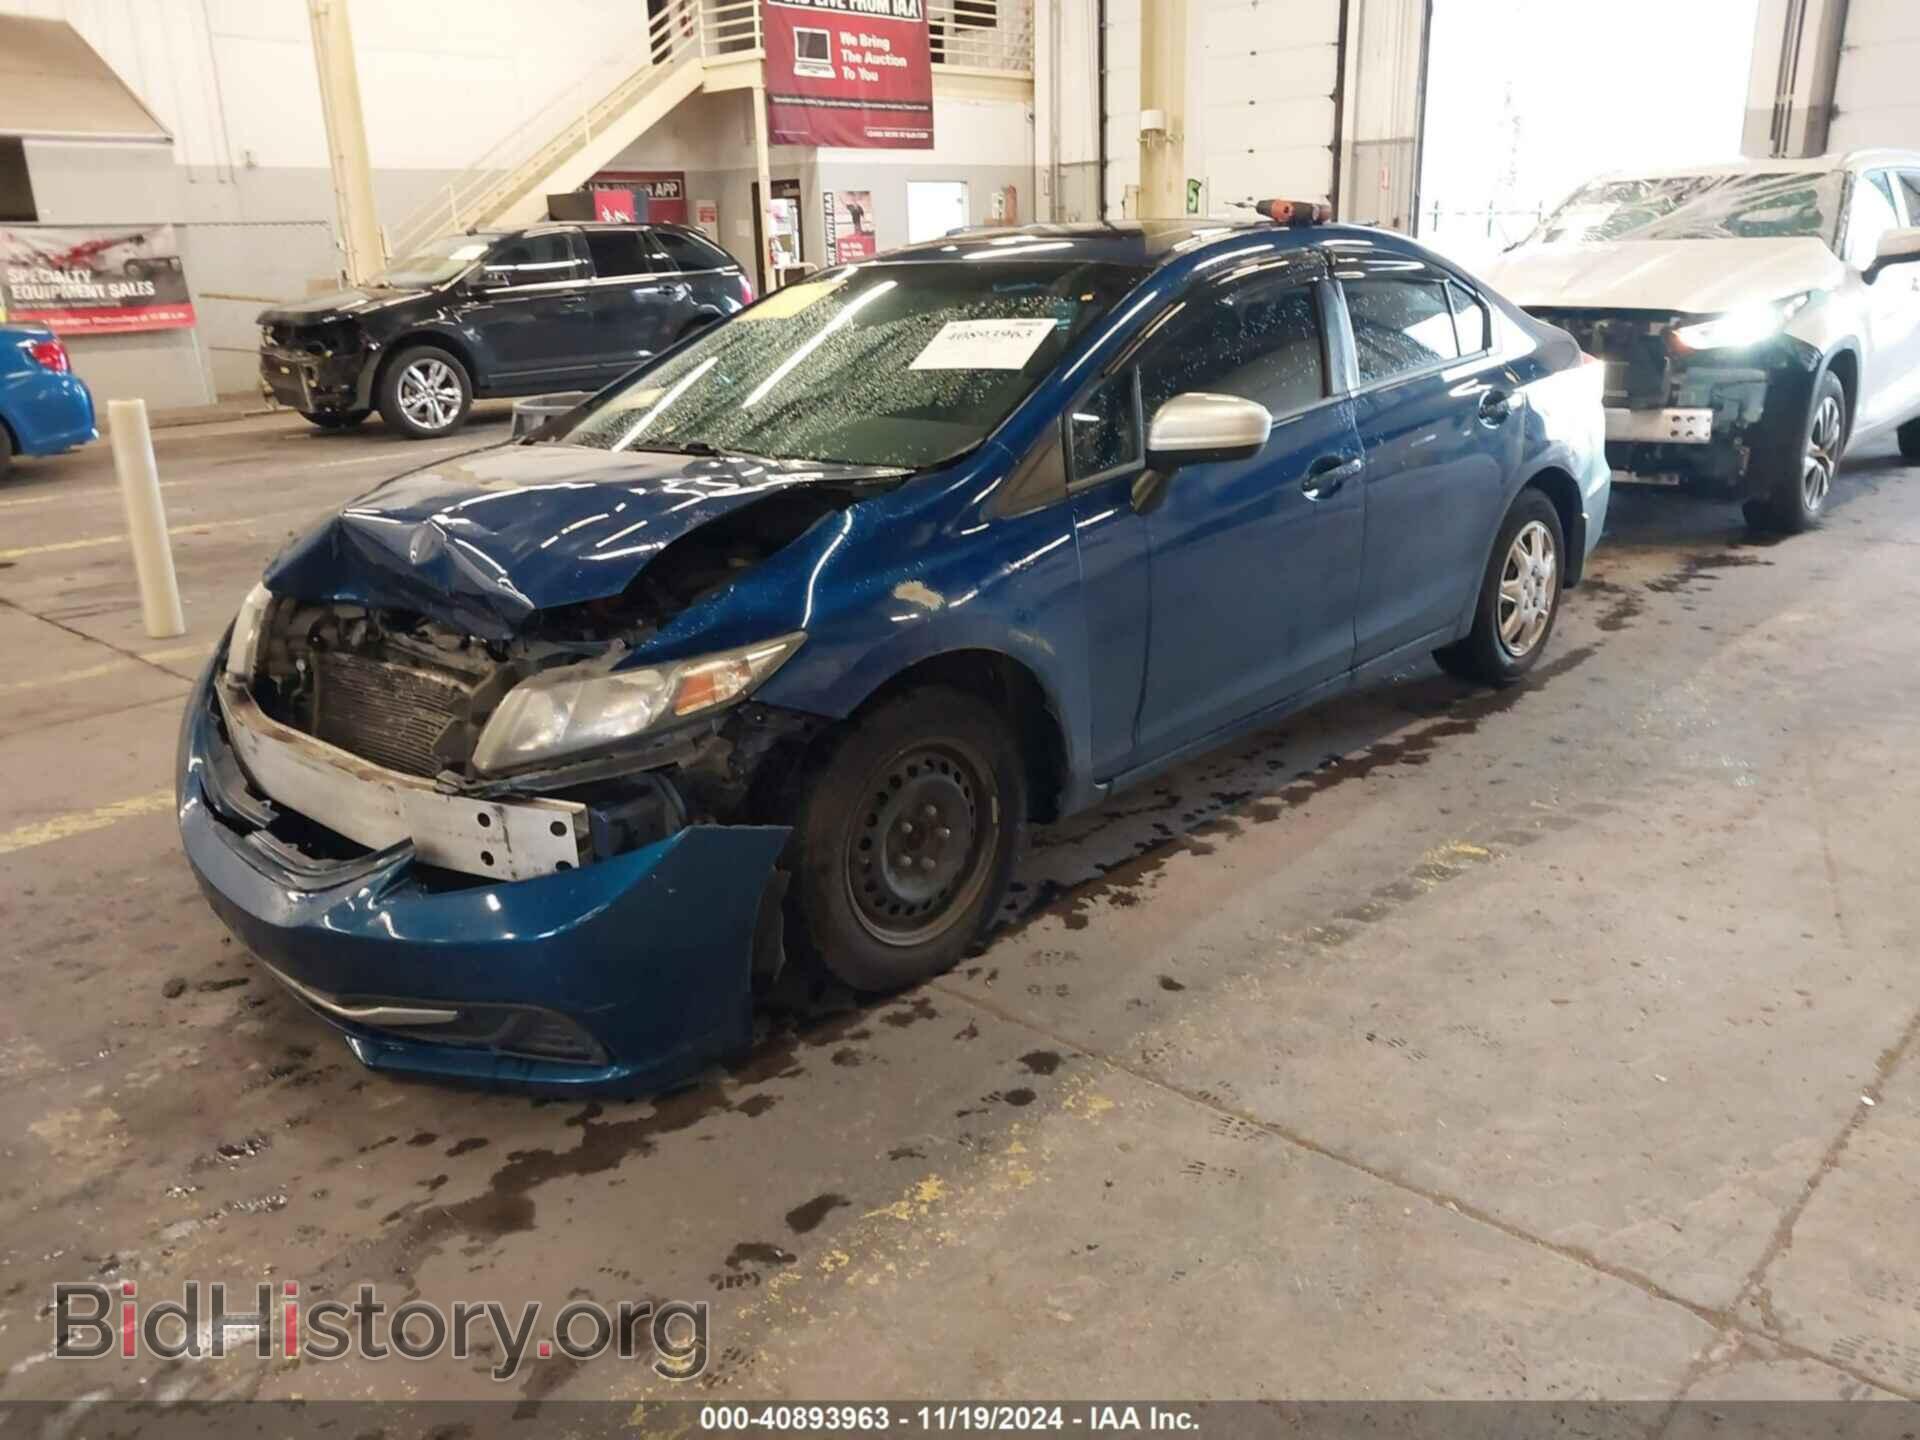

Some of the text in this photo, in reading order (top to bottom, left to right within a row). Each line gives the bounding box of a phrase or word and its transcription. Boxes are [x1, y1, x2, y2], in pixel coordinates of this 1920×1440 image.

[840, 31, 890, 51] We Bring
[841, 49, 908, 67] The Auction
[842, 66, 879, 82] To You
[654, 181, 679, 198] APP
[7, 269, 92, 284] SPECIALTY
[10, 281, 156, 300] EQUIPMENT SALES
